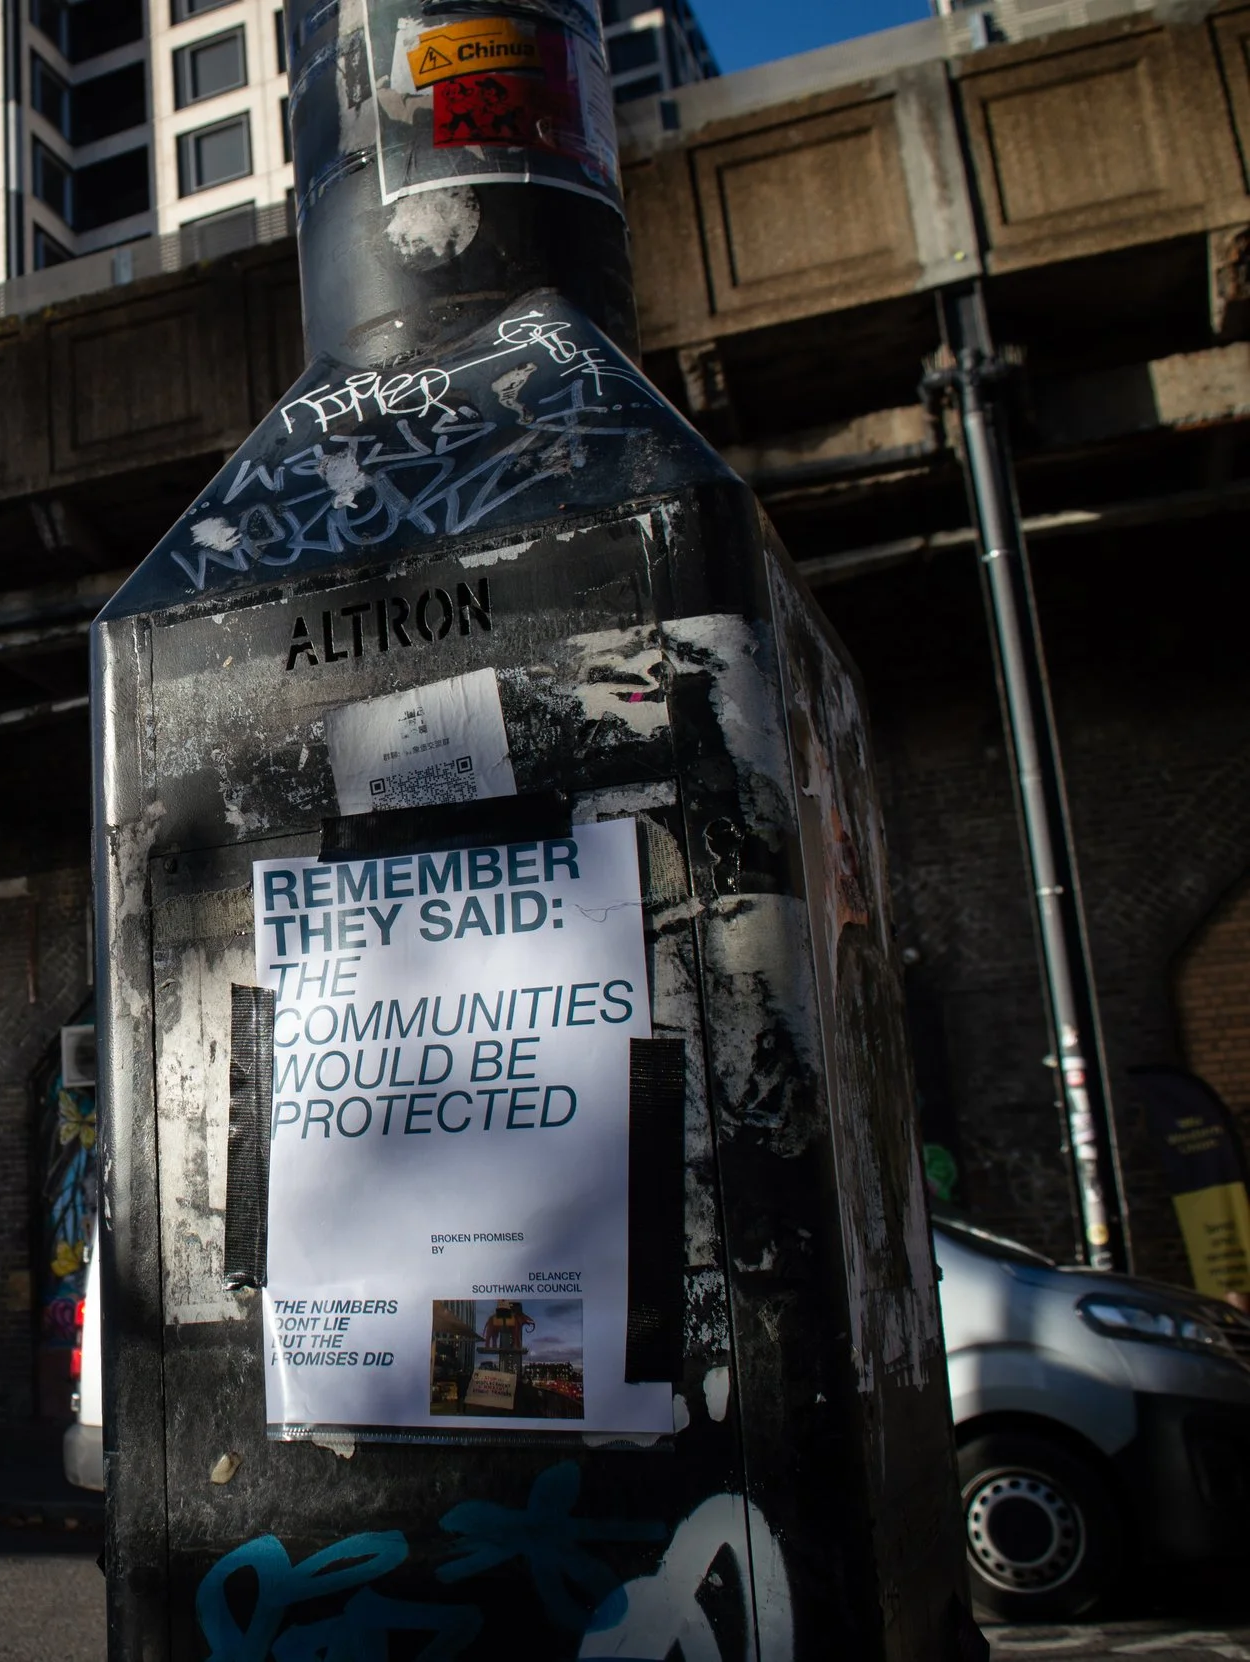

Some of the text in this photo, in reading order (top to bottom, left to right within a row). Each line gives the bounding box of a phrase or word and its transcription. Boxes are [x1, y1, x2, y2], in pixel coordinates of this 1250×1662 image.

[457, 40, 535, 62] Chinua
[286, 577, 493, 671] ALTRON
[263, 838, 580, 911] REMEMBER
[263, 889, 565, 956] THEY SAID:
[270, 955, 362, 1002] THE
[274, 980, 634, 1048] COMMUNITIES
[274, 1036, 541, 1094] WOULD BE
[271, 1084, 578, 1141] PROTECTED
[431, 1232, 524, 1243] BROKEN PROMISES
[431, 1246, 444, 1254] BY
[528, 1271, 582, 1281] DELANCEY
[472, 1283, 583, 1294] SOUTHWARK COUNCIL
[274, 1300, 398, 1314] THE NUMBERS
[323, 1317, 350, 1331] LIE
[311, 1334, 343, 1348] THE
[363, 1352, 395, 1366] DID
